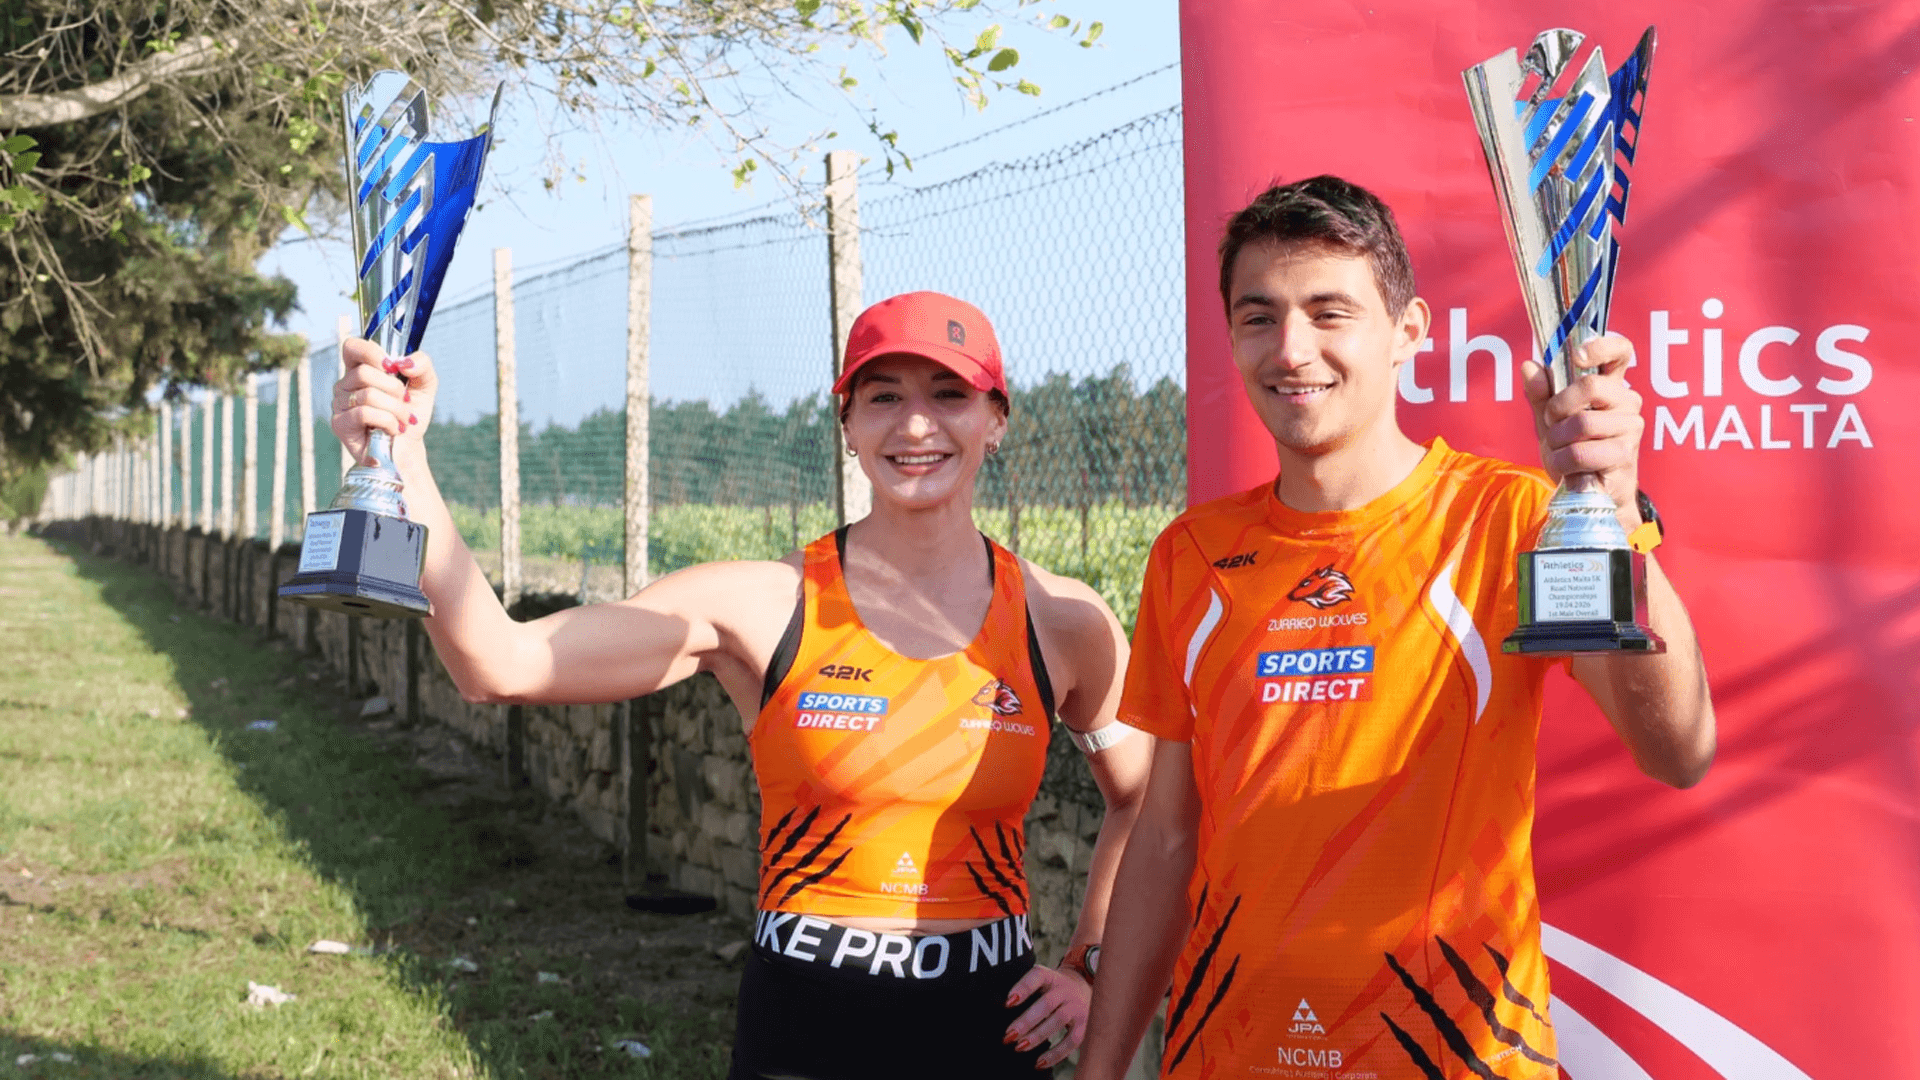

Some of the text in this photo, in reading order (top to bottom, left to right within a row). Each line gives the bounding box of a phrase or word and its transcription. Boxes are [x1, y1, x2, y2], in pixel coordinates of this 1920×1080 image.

[1398, 297, 1873, 404] thtics
[1653, 403, 1874, 450] MALTA
[1213, 550, 1258, 569] 42K
[1543, 561, 1584, 570] Athletics
[1548, 593, 1598, 601] Championships
[1267, 613, 1368, 632] ZURRIEQ WOLVES
[1263, 649, 1367, 674] SPORTS
[818, 664, 874, 682] 42K
[1262, 678, 1365, 702] DIRECT
[802, 693, 883, 713] SPORTS
[797, 713, 880, 731] DIRECT
[1003, 721, 1036, 736] WOLVES
[880, 882, 929, 896] NCMB
[755, 909, 1034, 979] IKE PRO NIK
[1288, 1023, 1325, 1034] JPA
[1278, 1047, 1342, 1068] NCMB
